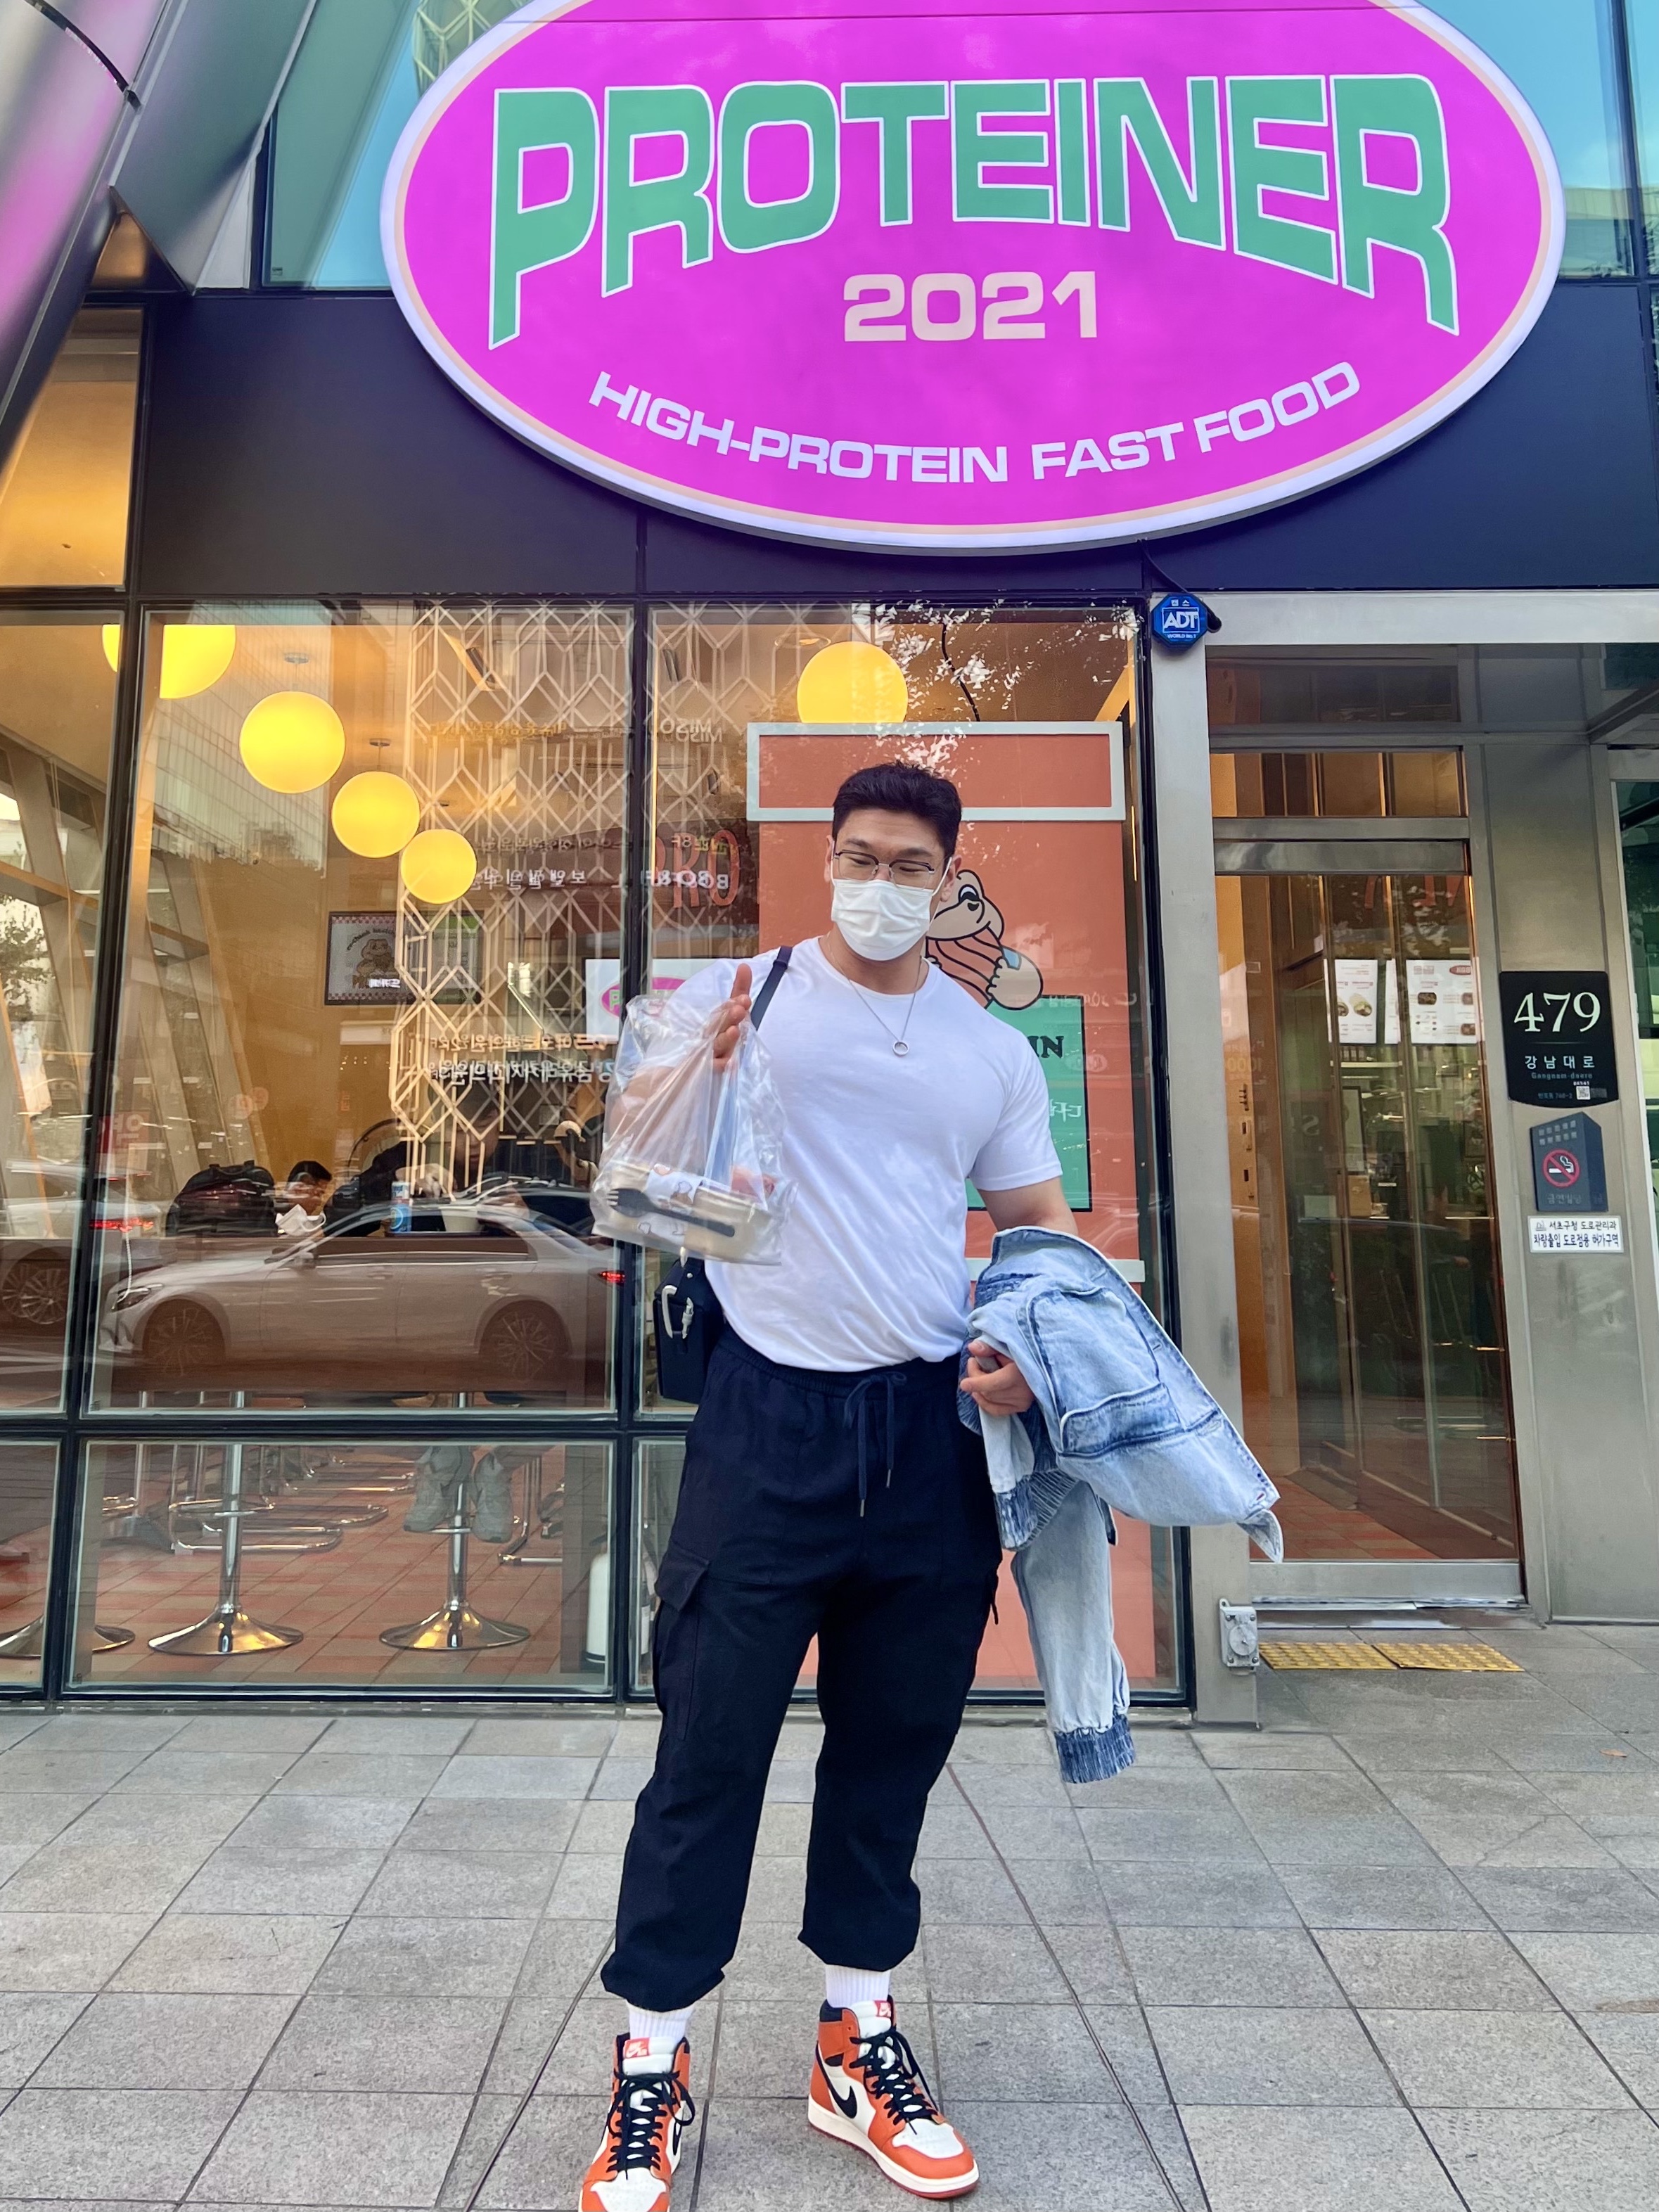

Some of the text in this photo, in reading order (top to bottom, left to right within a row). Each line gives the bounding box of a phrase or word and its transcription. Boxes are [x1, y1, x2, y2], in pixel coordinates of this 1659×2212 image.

[488, 72, 1459, 350] PROTEINER
[843, 271, 1097, 343] 2021
[588, 362, 1361, 483] HIGH-PROTEIN FAST FOOD
[1164, 611, 1198, 629] ADT
[1513, 992, 1601, 1032] 479
[1525, 1056, 1595, 1069] 강남대로
[1549, 1220, 1617, 1231] 서초구청 도로관리과
